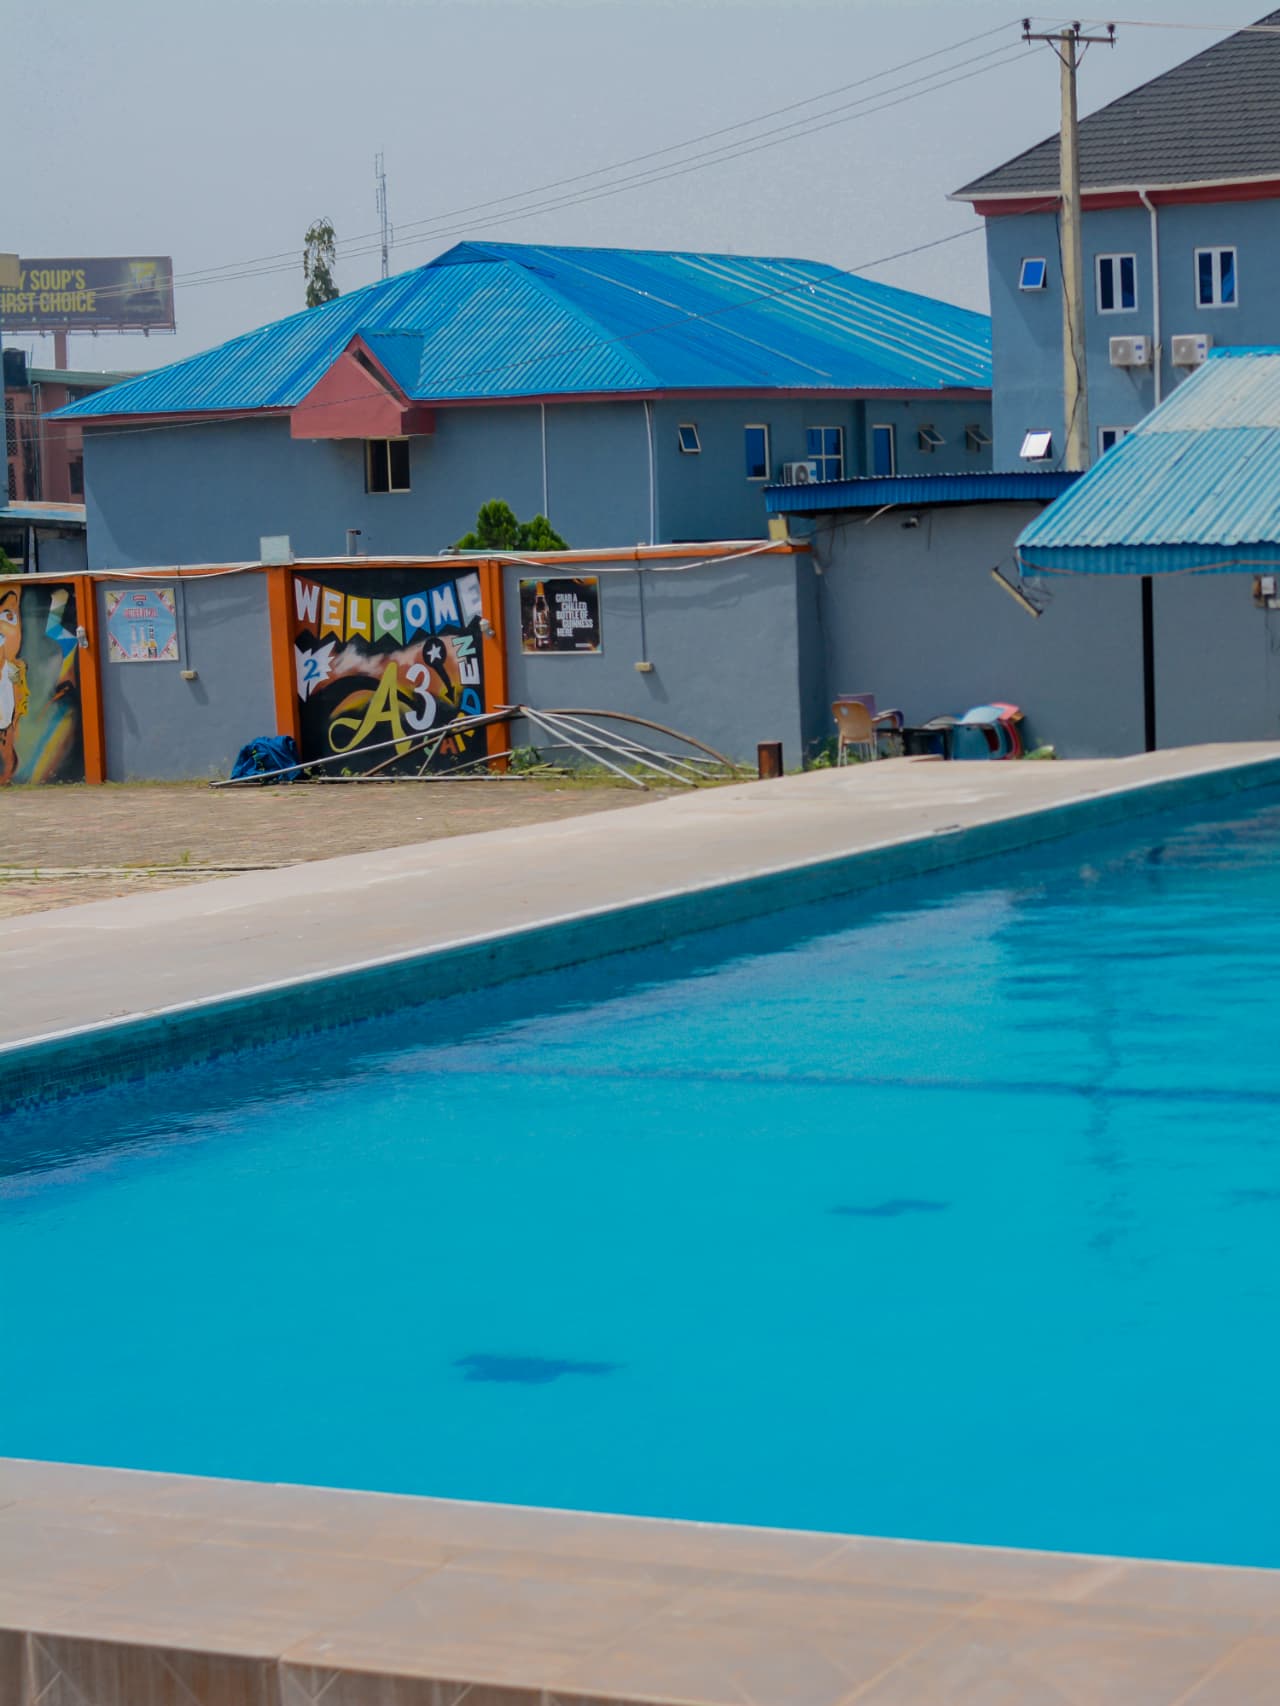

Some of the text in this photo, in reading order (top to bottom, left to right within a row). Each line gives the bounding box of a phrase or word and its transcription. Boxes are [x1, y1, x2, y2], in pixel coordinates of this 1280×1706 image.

[30, 270, 86, 290] SOUP'S
[0, 291, 96, 313] IRST CHOICE
[555, 593, 572, 602] GRAB
[294, 575, 481, 631] WELCOME
[561, 602, 587, 611] CHILLED
[556, 610, 588, 620] BOTTLE OF
[562, 619, 593, 628] GUINNESS
[557, 628, 573, 637] HERE
[303, 659, 321, 681] 2
